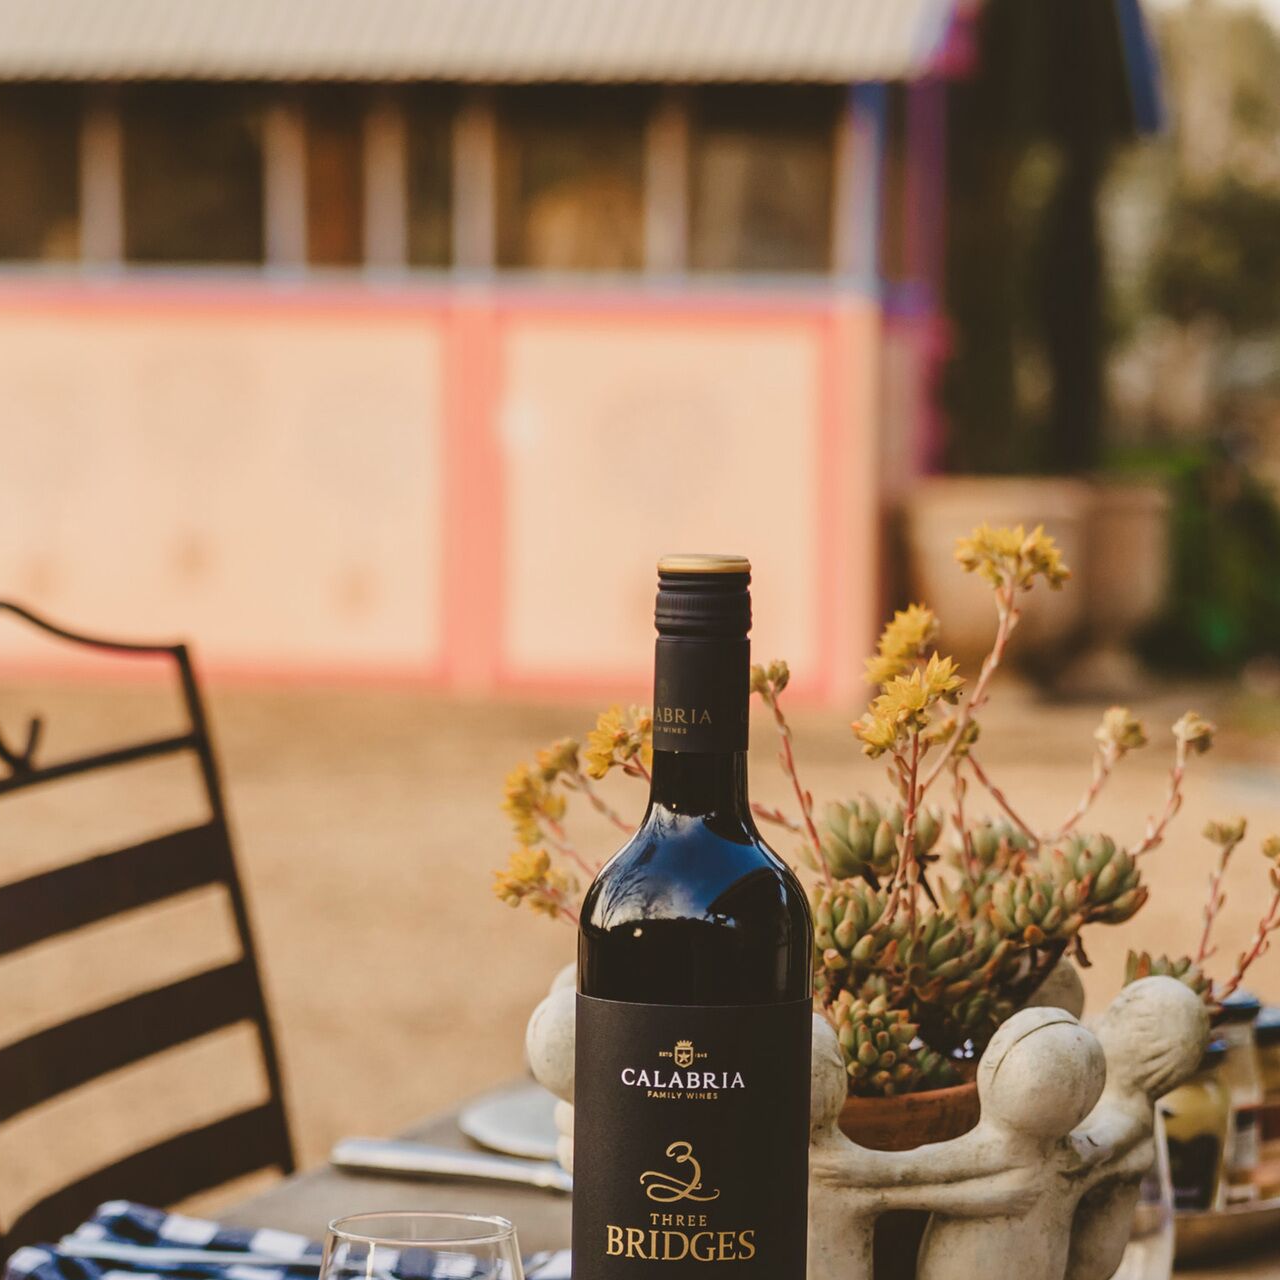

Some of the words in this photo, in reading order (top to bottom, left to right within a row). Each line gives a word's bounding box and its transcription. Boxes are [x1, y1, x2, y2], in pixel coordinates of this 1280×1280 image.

[621, 1068, 745, 1089] CALABRIA
[647, 1091, 682, 1099] FAMILY
[686, 1092, 718, 1100] WINES
[650, 1213, 707, 1227] THREE
[606, 1225, 756, 1262] BRIDGES
